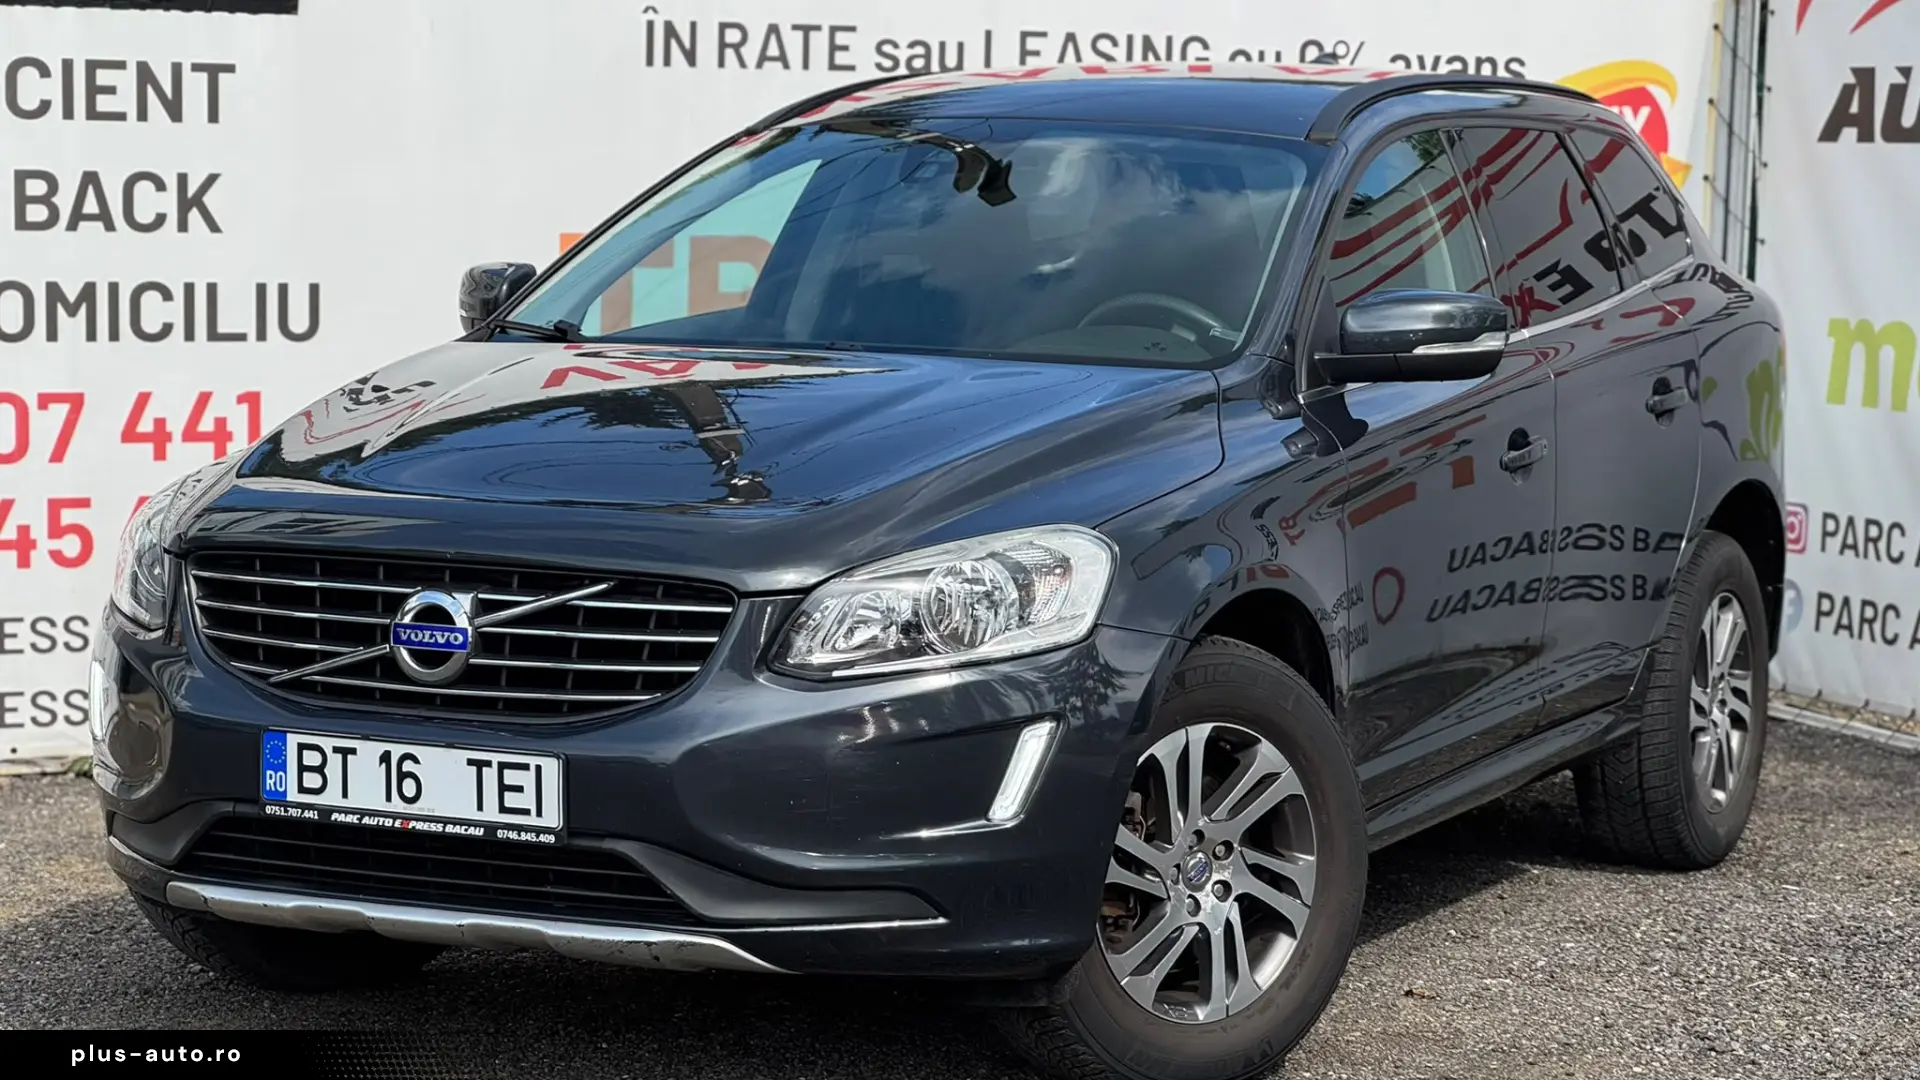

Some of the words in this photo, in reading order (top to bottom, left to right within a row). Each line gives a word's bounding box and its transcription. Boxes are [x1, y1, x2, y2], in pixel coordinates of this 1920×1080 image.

[642, 6, 697, 68] ÎN
[717, 23, 858, 71] RATE
[874, 38, 965, 71] sau
[4, 56, 236, 124] CIENT
[13, 169, 223, 233] BACK
[0, 280, 320, 343] OMICILIU
[120, 390, 262, 461] 441
[1821, 511, 1906, 565] PARC
[0, 615, 90, 655] ESS
[396, 627, 464, 645] VOLVO
[1814, 591, 1901, 646] PARC
[0, 689, 89, 729] ESS
[266, 770, 286, 792] RO
[297, 742, 357, 799] BT
[379, 749, 423, 805] 16
[466, 757, 543, 818] TEI
[265, 804, 319, 820] 0751.707.441
[331, 812, 361, 824] PARC
[361, 816, 393, 827] AUTO
[393, 819, 443, 832] EXPRESS
[444, 823, 485, 836] BACAU
[497, 829, 556, 844] 0746.845.409
